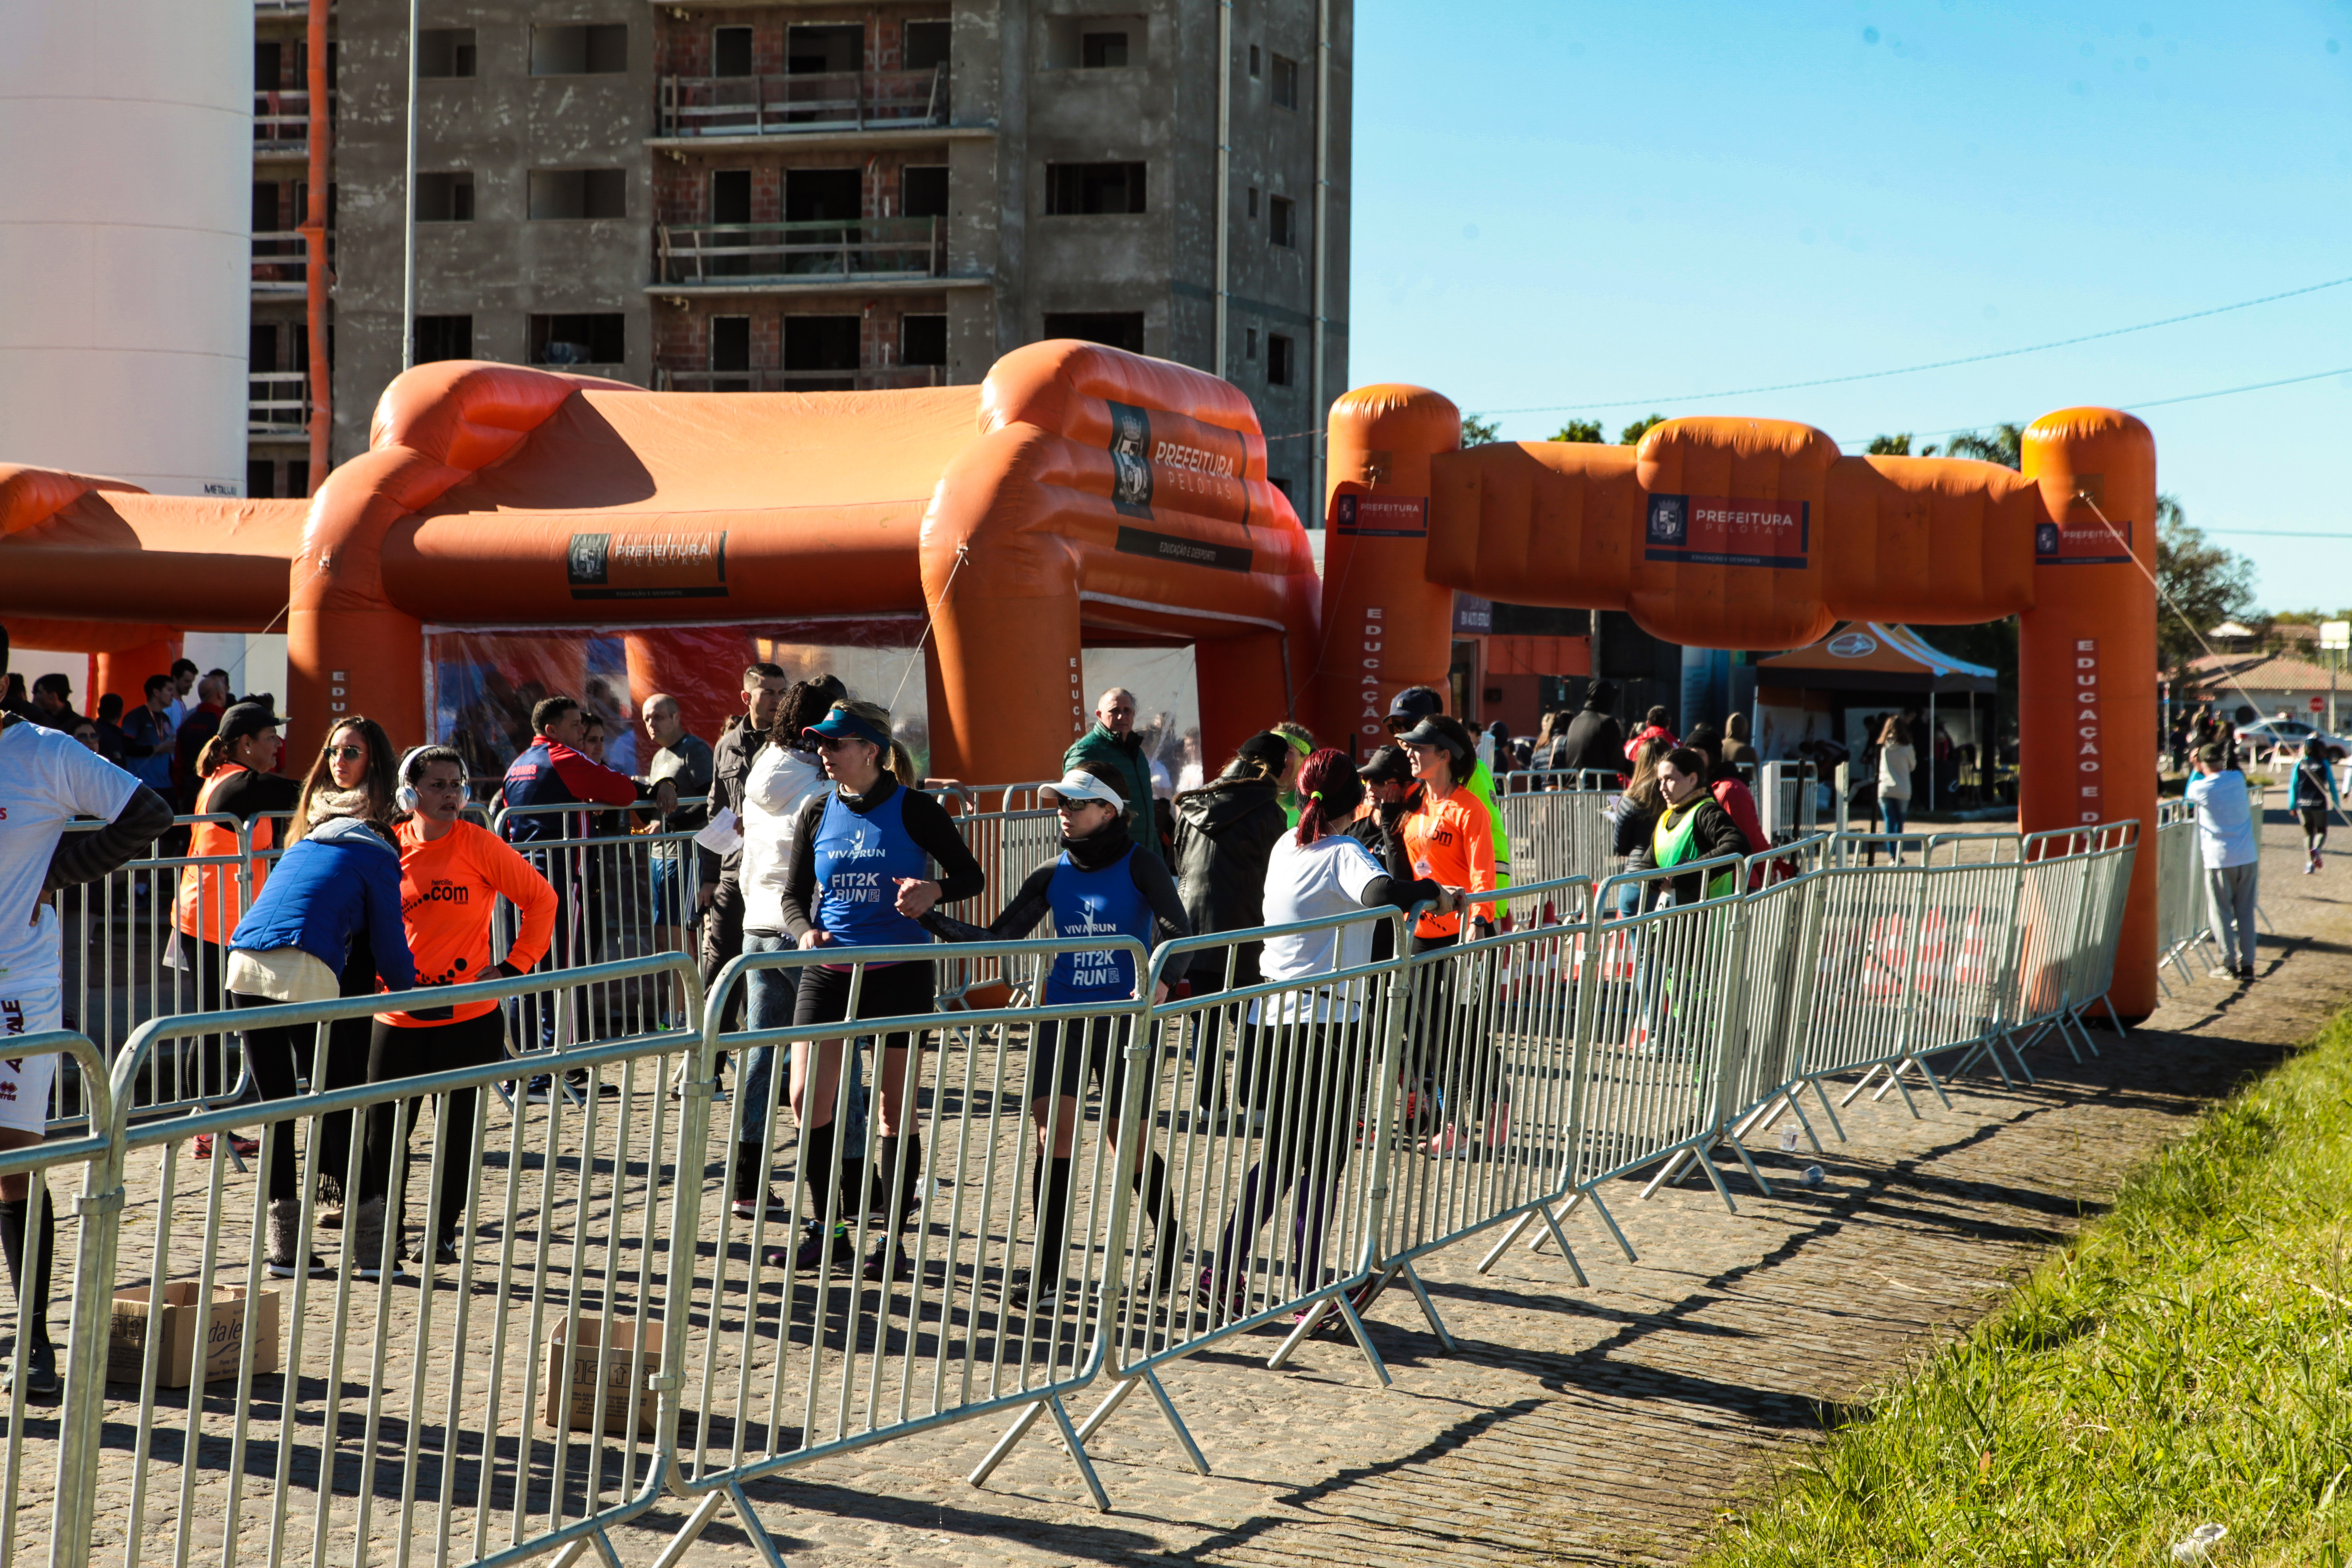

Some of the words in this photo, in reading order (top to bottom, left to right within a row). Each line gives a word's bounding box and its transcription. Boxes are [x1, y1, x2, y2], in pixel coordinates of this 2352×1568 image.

[1155, 441, 1233, 480] PREFEITURA
[1168, 471, 1231, 499] PELOTAS
[1361, 503, 1419, 512] PREFEITURA
[1696, 510, 1793, 526] PREFEITURA
[1706, 524, 1784, 536] PELOTAS
[2063, 530, 2124, 539] PREFEITURA
[615, 544, 709, 557] PREFEITURA
[1159, 542, 1187, 556] EDUCAÇÃO
[1187, 547, 1191, 557] E
[1191, 547, 1216, 561] DESPORTO
[624, 557, 700, 567] PELOTAS
[1361, 609, 1382, 734] EDUCAÇÃO
[2077, 640, 2099, 772] EDUCAÇÃO
[2082, 787, 2099, 797] E
[832, 873, 879, 887] FIT2K
[836, 889, 867, 903] RUN
[1074, 949, 1114, 968] FIT2K
[1072, 968, 1107, 986] RUN
